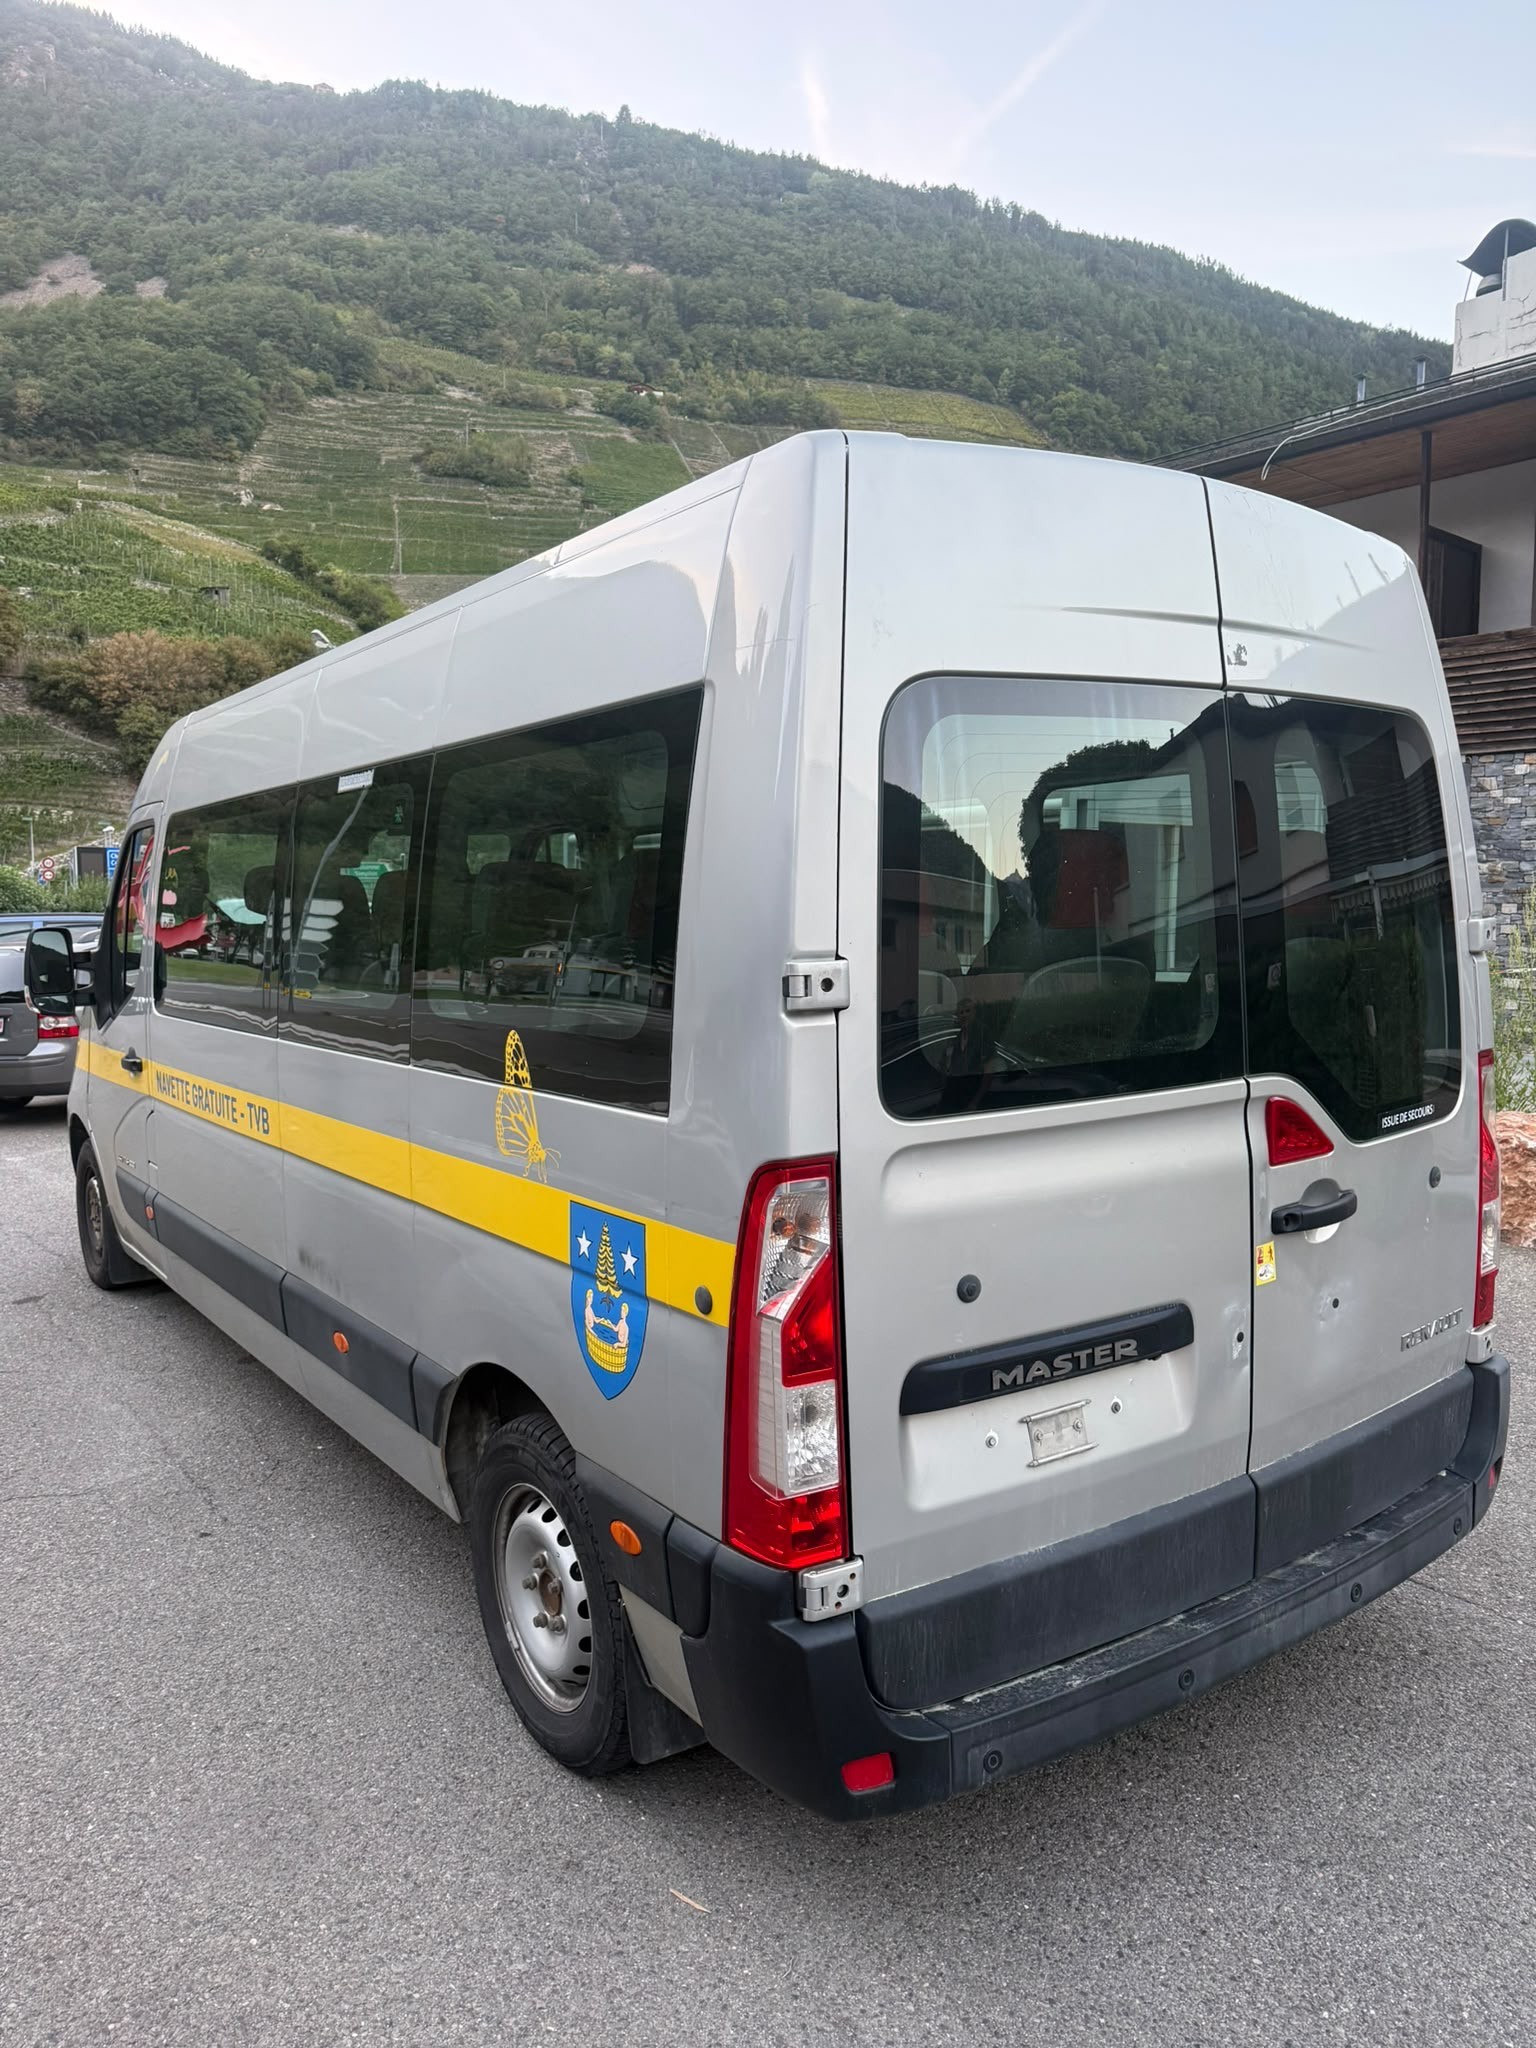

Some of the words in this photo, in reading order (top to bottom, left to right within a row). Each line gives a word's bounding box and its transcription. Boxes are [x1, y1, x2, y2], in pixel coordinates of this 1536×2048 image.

[156, 1069, 192, 1106] NAVETTE
[191, 1082, 238, 1124] GRATUITE
[247, 1101, 270, 1135] TVB
[1381, 1112, 1400, 1129] ISSUE
[1400, 1111, 1408, 1124] DE
[1408, 1103, 1435, 1121] SECOURS
[1400, 1306, 1463, 1353] RENAULT
[991, 1338, 1139, 1391] MASTER
